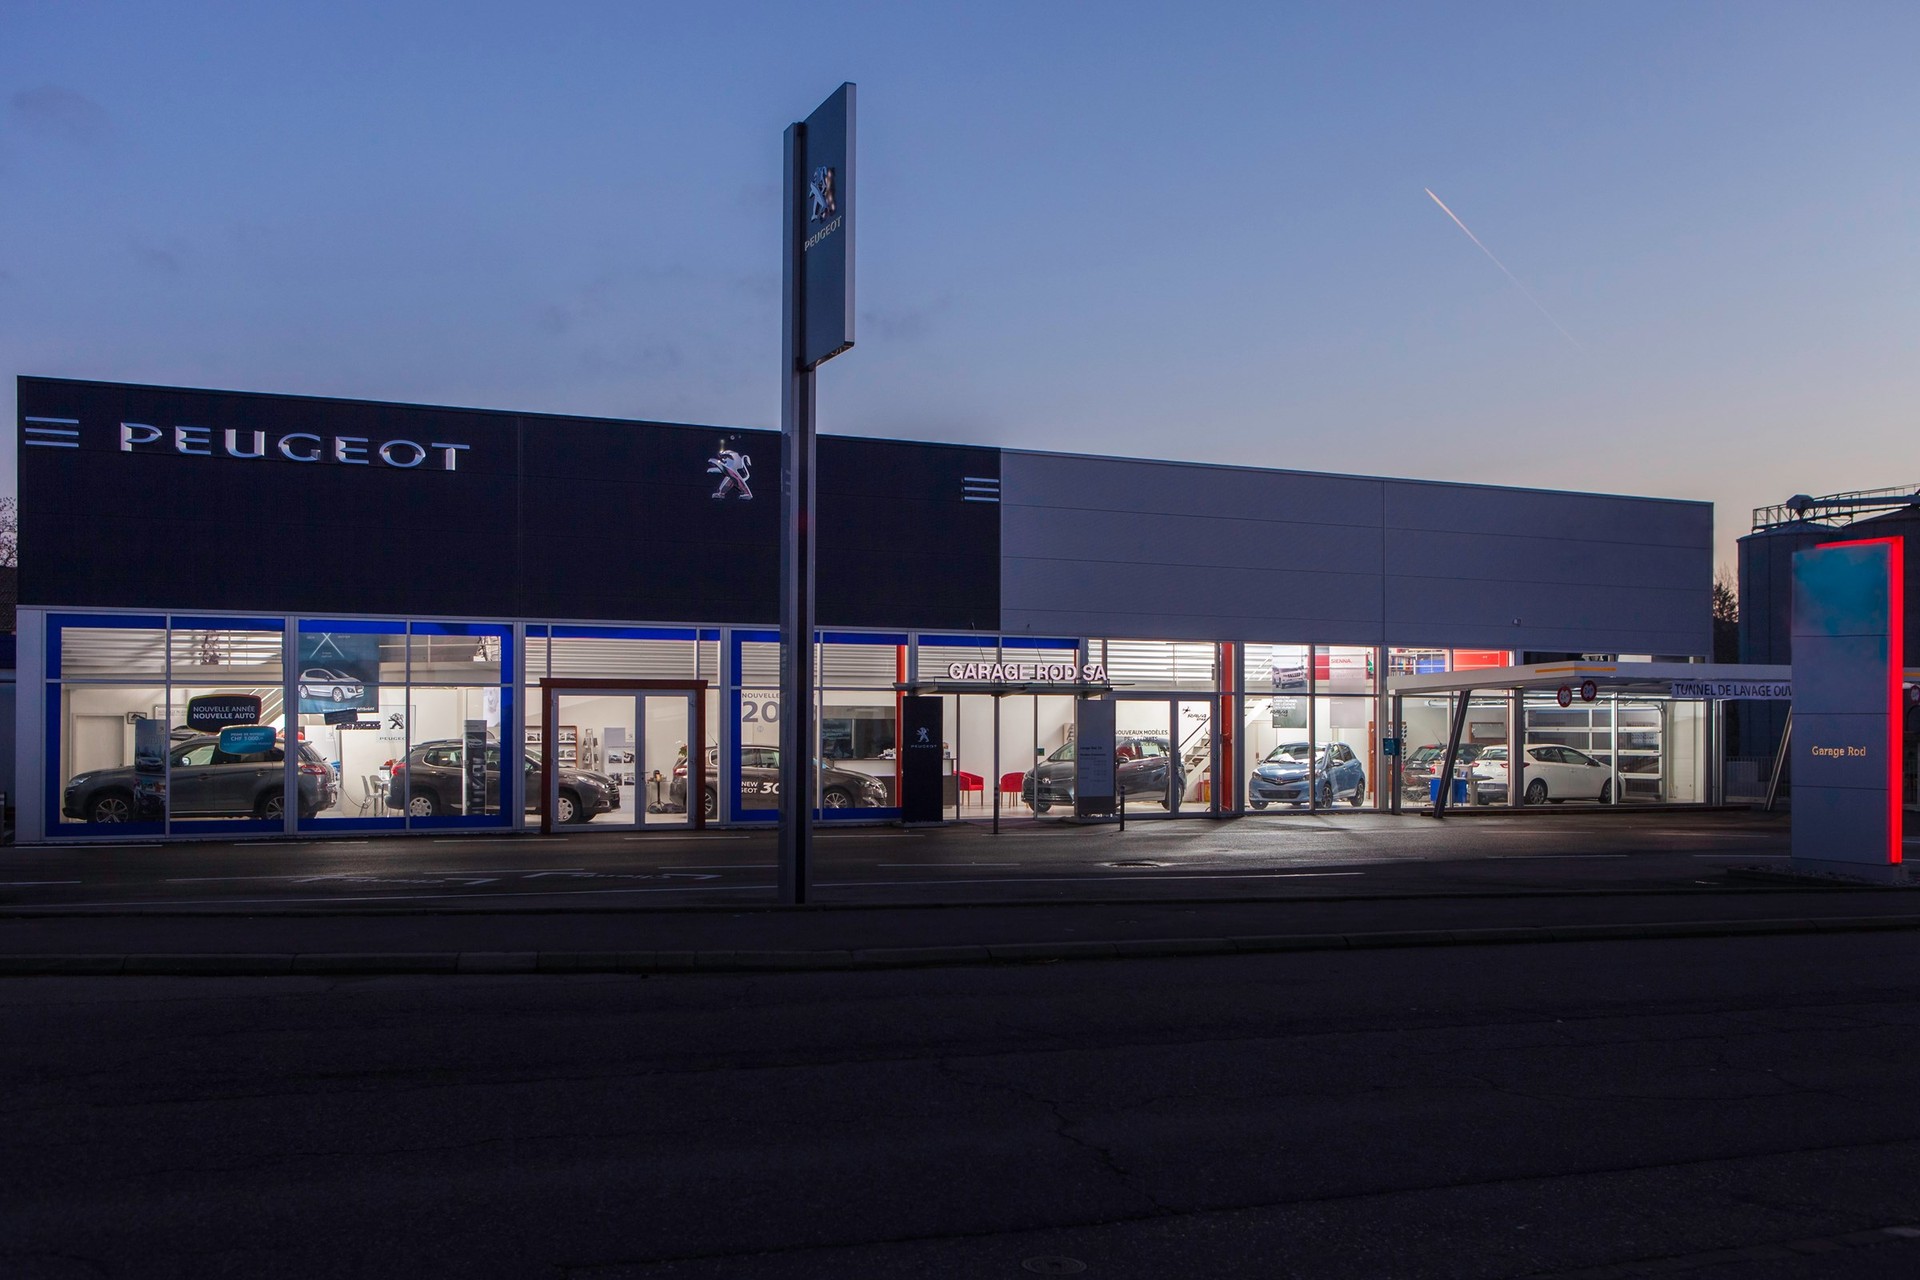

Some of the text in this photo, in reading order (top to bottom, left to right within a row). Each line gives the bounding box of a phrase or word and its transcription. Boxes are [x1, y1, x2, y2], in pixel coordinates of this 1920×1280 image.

[804, 215, 842, 251] PEUGEOT
[119, 421, 471, 471] PEUGEOT
[948, 662, 1108, 682] GARAGE ROD SA
[1675, 683, 1792, 697] TUNNEL DE LAVAGE OUV
[742, 701, 780, 723] 20
[1811, 746, 1866, 759] Garage Rod
[760, 782, 780, 794] 30
